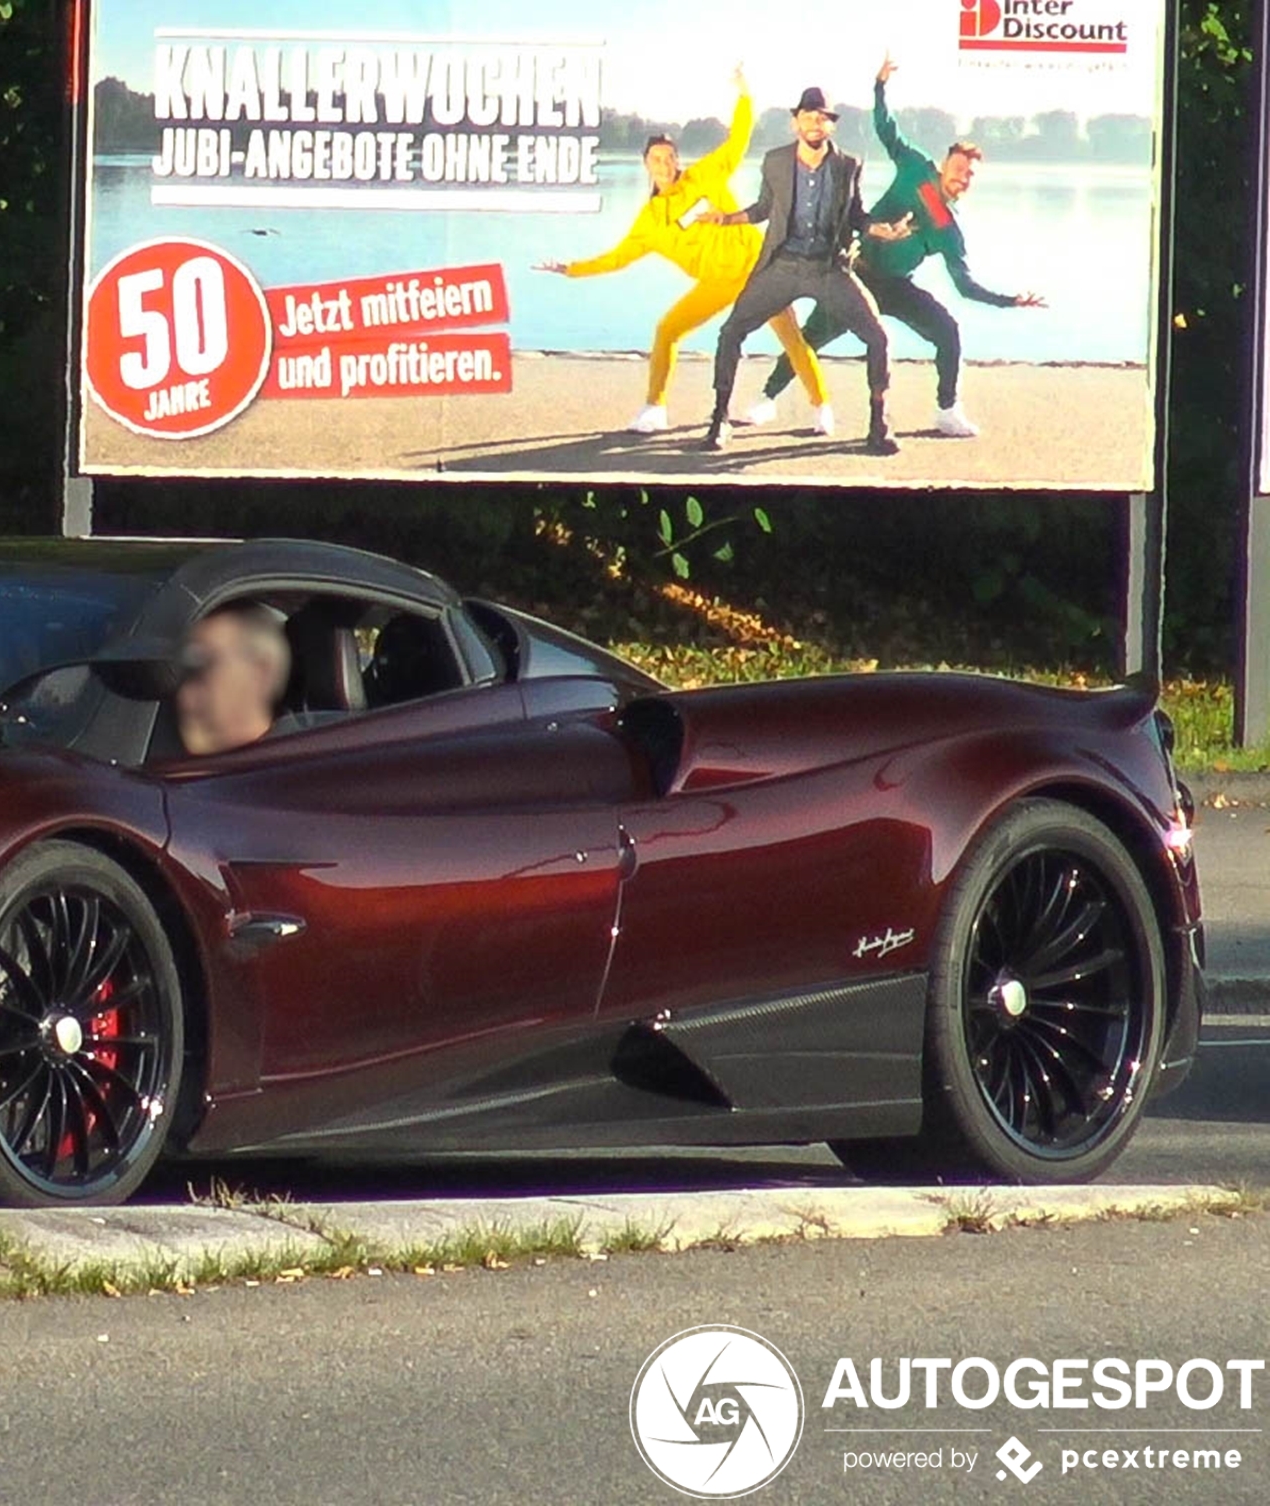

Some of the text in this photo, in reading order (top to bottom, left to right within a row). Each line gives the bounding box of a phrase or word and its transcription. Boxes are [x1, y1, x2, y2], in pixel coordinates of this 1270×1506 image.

[1003, 0, 1073, 15] Inter
[1003, 18, 1127, 40] Discount
[154, 45, 601, 127] KNALLERWOCHEN
[152, 128, 599, 184] JUBI-ANGEBOTE OHNE ENDE
[118, 256, 228, 389] 50
[279, 277, 493, 338] Jetzt mitfeiern
[278, 343, 502, 397] und profitieren.
[144, 379, 211, 421] JAHRE
